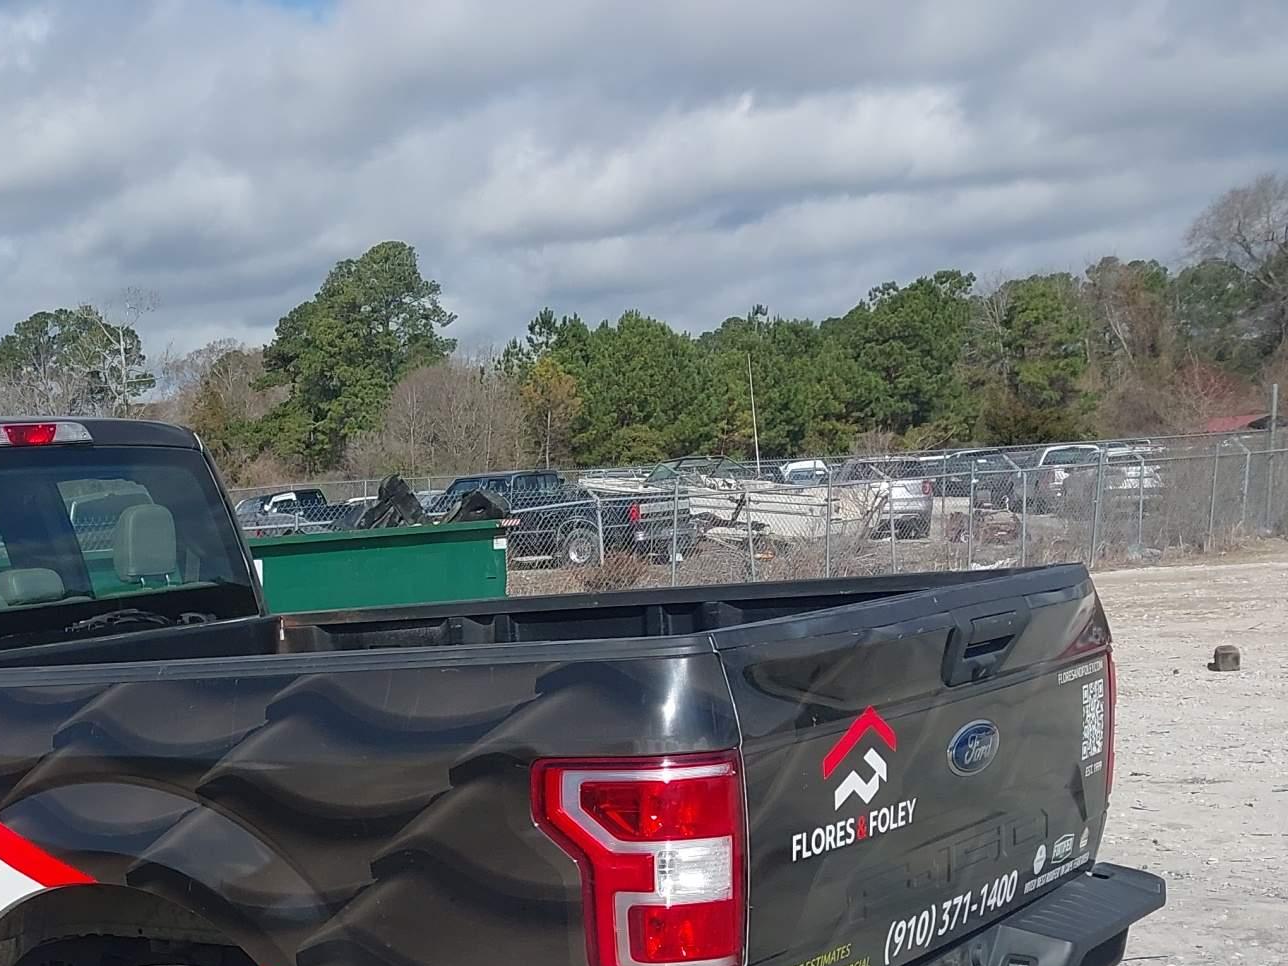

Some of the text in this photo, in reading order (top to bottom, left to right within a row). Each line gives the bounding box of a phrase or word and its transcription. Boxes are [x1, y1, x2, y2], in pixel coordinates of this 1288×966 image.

[964, 732, 997, 765] Ford
[884, 870, 1018, 965] (910) 371-1400
